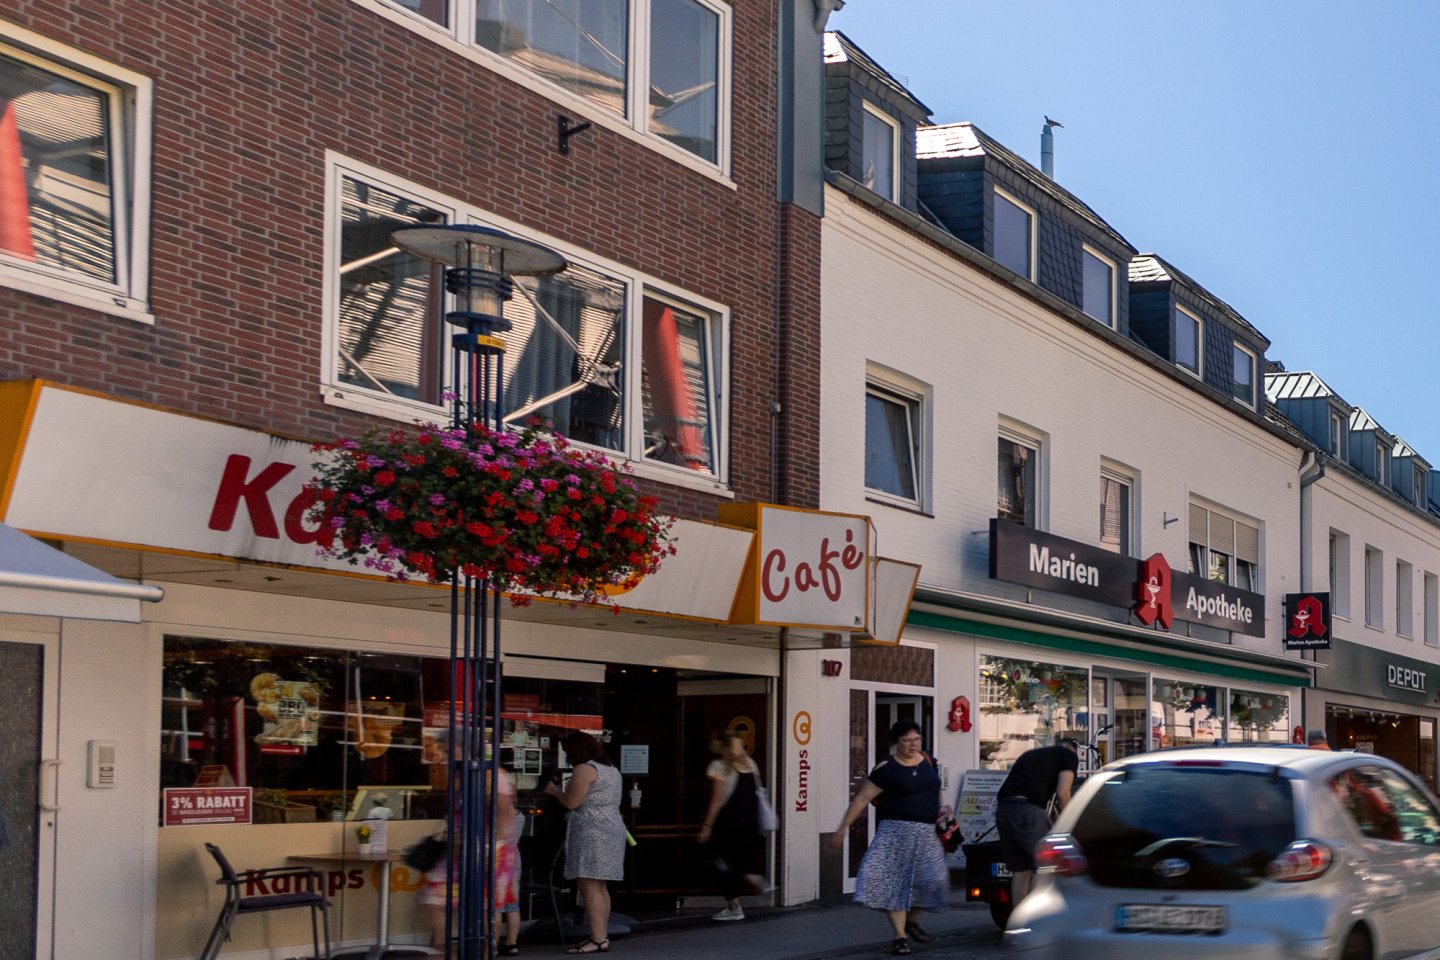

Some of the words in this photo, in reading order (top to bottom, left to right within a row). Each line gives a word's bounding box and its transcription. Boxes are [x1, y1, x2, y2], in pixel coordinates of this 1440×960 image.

[762, 529, 864, 603] Café
[1029, 543, 1099, 587] Marien
[1185, 586, 1253, 624] Apotheke
[1388, 664, 1426, 690] DEPOT
[171, 796, 193, 809] 3%
[196, 796, 246, 808] RABATT
[796, 749, 811, 812] Kamps
[246, 868, 364, 897] Kamps
